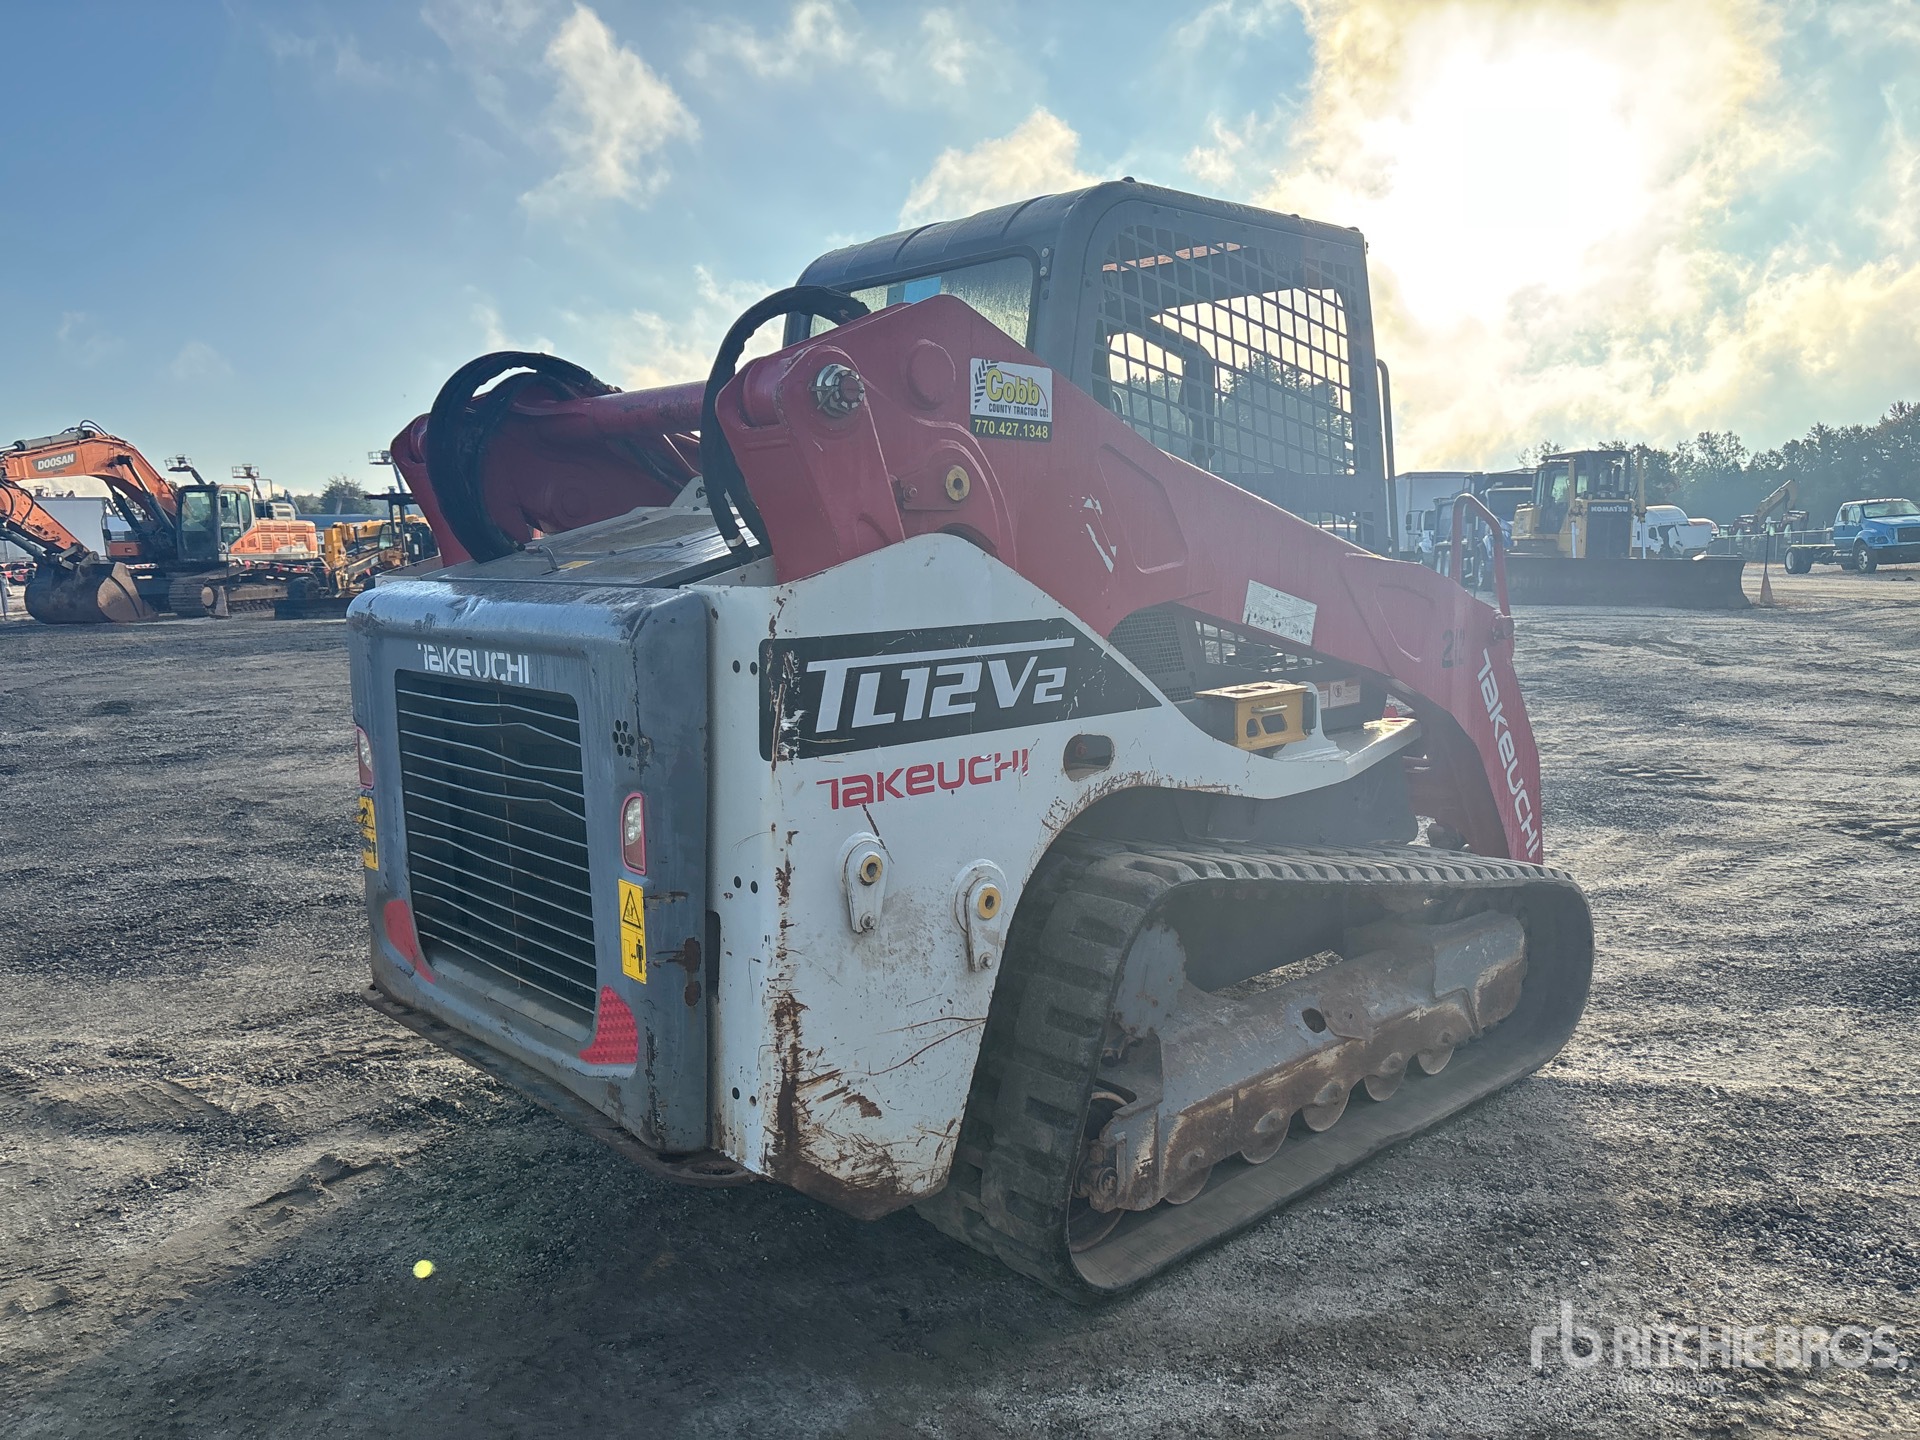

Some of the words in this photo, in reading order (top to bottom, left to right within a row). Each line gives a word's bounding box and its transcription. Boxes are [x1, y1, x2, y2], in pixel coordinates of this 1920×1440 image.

[985, 368, 1040, 406] Cobb
[974, 419, 1049, 439] 770.427.1348
[989, 403, 1012, 415] COUNTY
[1013, 405, 1038, 417] TRACTOR
[37, 453, 75, 470] DOOSAN
[1590, 505, 1629, 513] KOMATSU
[417, 643, 530, 684] TAKEUCHI
[806, 637, 1075, 734] TL12V2
[1477, 647, 1541, 859] TAKEUCHI
[816, 748, 1029, 810] TAKEUCHI
